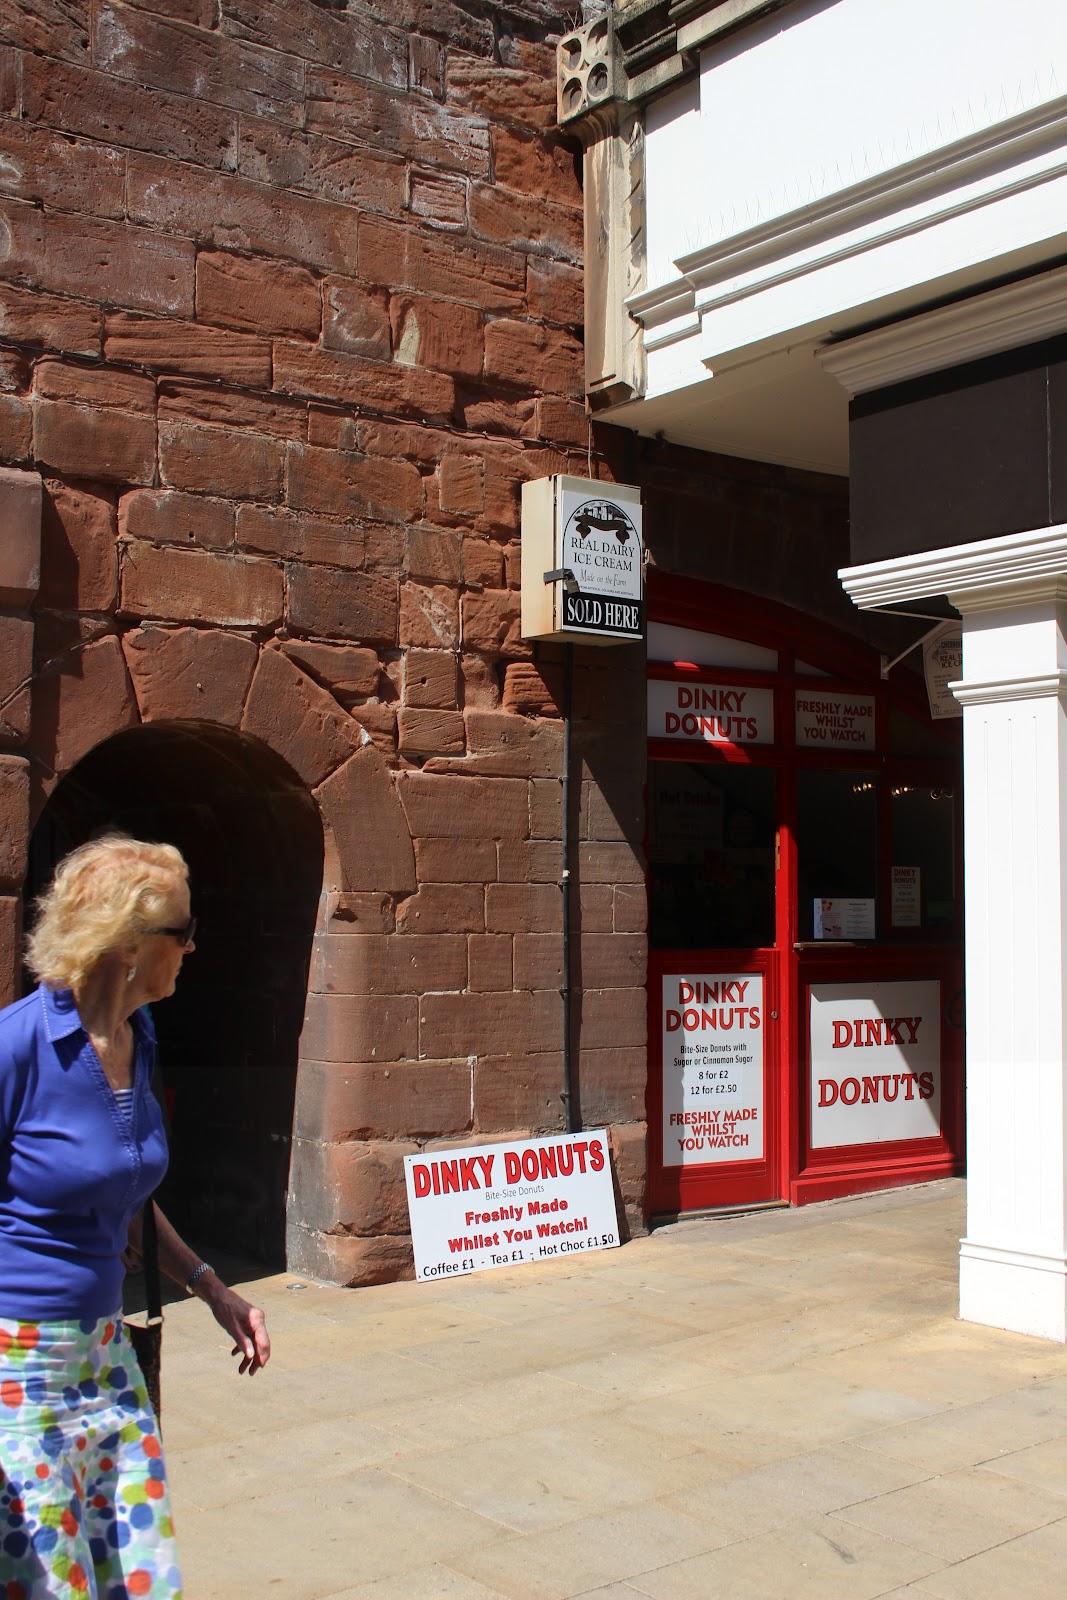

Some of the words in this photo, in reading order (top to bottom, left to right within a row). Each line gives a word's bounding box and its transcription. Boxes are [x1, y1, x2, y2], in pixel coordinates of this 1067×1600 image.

[570, 537, 600, 551] REAL
[602, 542, 635, 557] DAIRY
[573, 552, 592, 565] ICE
[594, 555, 632, 572] CREAM
[579, 568, 595, 583] Made
[596, 575, 604, 584] on
[605, 574, 613, 585] the
[613, 573, 627, 587] Farm
[567, 597, 602, 624] SOLD
[604, 602, 640, 630] HERE
[677, 686, 747, 713] DINKY
[796, 700, 841, 714] FRESHLY
[843, 703, 873, 717] MADE
[665, 711, 758, 739] DONUTS
[815, 714, 855, 729] WHILST
[803, 727, 827, 740] YOU
[829, 728, 866, 743] WATCH
[893, 867, 916, 877] DINKY
[678, 980, 750, 1005] DINKY
[665, 1006, 760, 1032] DONUTS
[832, 1016, 922, 1048] DINKY
[680, 1044, 709, 1055] Bite-Size
[710, 1043, 732, 1053] Donuts
[733, 1042, 747, 1052] with
[673, 1056, 692, 1067] Sugar
[694, 1057, 702, 1065] or
[702, 1055, 734, 1065] Cinnamon
[735, 1054, 754, 1066] Sugar
[698, 1071, 704, 1080] 8
[705, 1070, 718, 1080] for
[719, 1070, 729, 1079] £2
[690, 1085, 700, 1095] 12
[702, 1084, 714, 1094] for
[715, 1083, 738, 1094] £2.50
[818, 1071, 935, 1107] DONUTS
[669, 1110, 721, 1126] FRESHLY
[723, 1107, 758, 1122] MADE
[691, 1122, 737, 1137] WHILST
[677, 1137, 704, 1151] YOU
[707, 1133, 749, 1149] WATCH
[412, 1154, 495, 1199] DINKY
[504, 1139, 605, 1185] DONUTS
[485, 1188, 517, 1201] Bite-Size
[518, 1184, 545, 1197] Donuts
[465, 1205, 524, 1226] Freshly
[527, 1198, 569, 1216] Made
[448, 1232, 500, 1253] Whilst
[503, 1227, 533, 1244] You
[536, 1216, 589, 1238] Watch!
[423, 1261, 459, 1277] Coffee
[462, 1258, 475, 1271] £1
[490, 1254, 509, 1266] Tea
[511, 1249, 524, 1261] £1
[539, 1244, 558, 1257] Hot
[560, 1239, 585, 1252] Choc
[587, 1232, 614, 1248] £1.50
